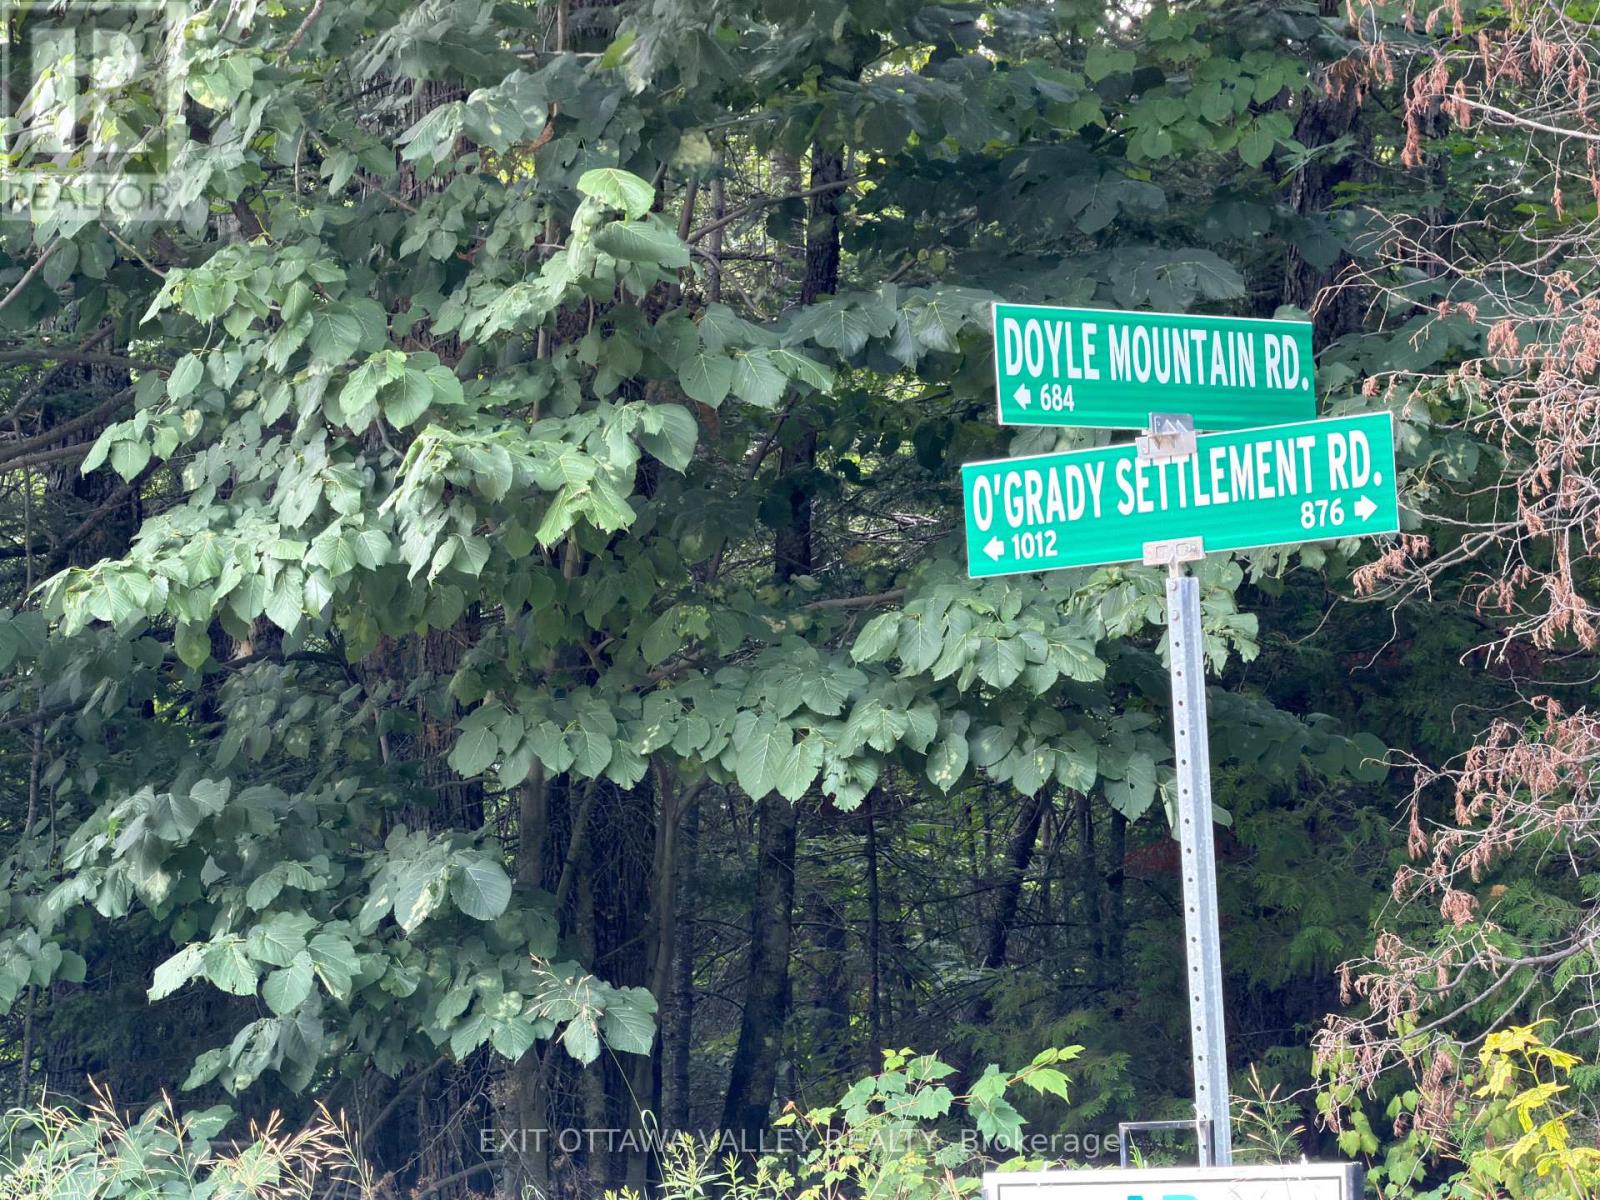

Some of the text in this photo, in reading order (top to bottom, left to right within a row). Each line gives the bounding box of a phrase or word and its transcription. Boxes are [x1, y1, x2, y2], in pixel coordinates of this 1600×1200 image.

[1003, 317, 1310, 391] DOYLE MOUNTAIN RD.
[1040, 384, 1075, 412] 684
[972, 429, 1383, 532] O'GRADY SETTLEMENT RD.
[1300, 497, 1346, 530] 876
[1011, 530, 1059, 560] 1012
